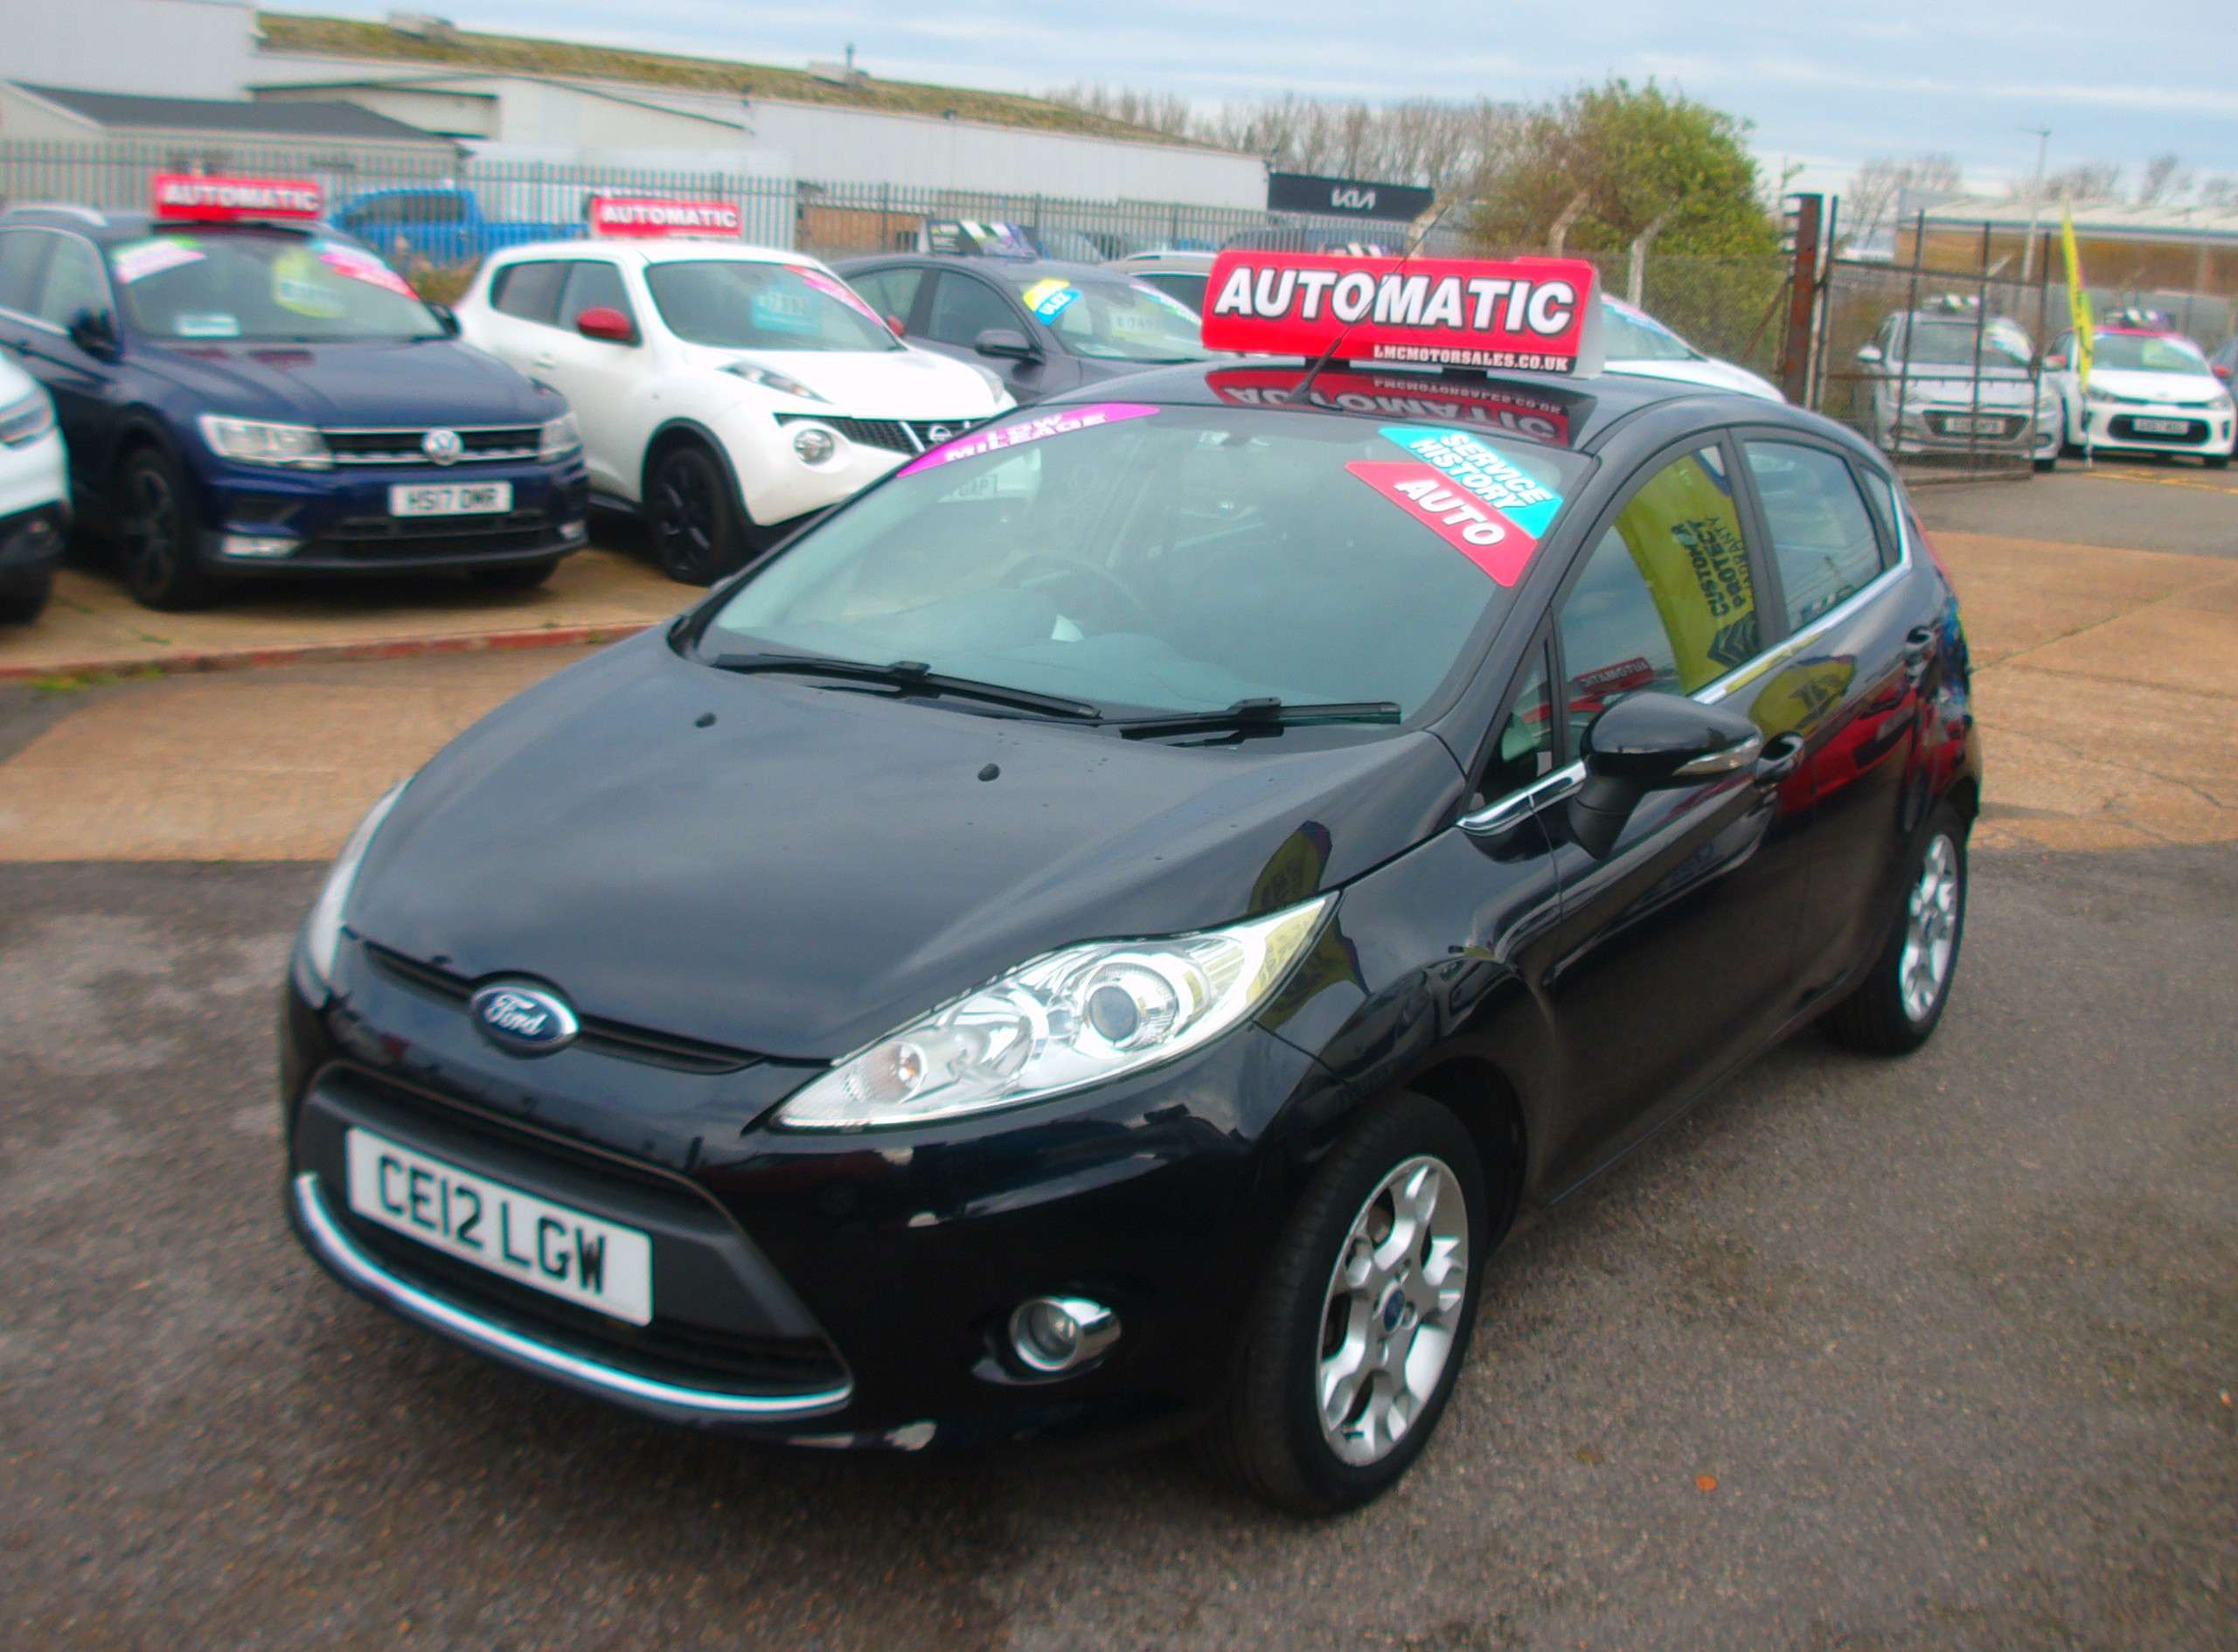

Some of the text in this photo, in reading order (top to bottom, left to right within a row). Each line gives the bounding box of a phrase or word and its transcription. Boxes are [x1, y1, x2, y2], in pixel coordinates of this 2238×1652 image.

[164, 183, 319, 211] AUTOMATIC
[601, 206, 738, 227] AUTOMATIC
[1213, 265, 1575, 336] AUTOMATIC
[1373, 344, 1569, 371] LMCMOTORSALES.CO.UK
[1409, 438, 1528, 509] HISTORY
[1441, 432, 1553, 504] SERVICE
[1394, 479, 1505, 545] AUTO
[484, 994, 548, 1035] Ford
[379, 1155, 606, 1295] CE12 LGW
